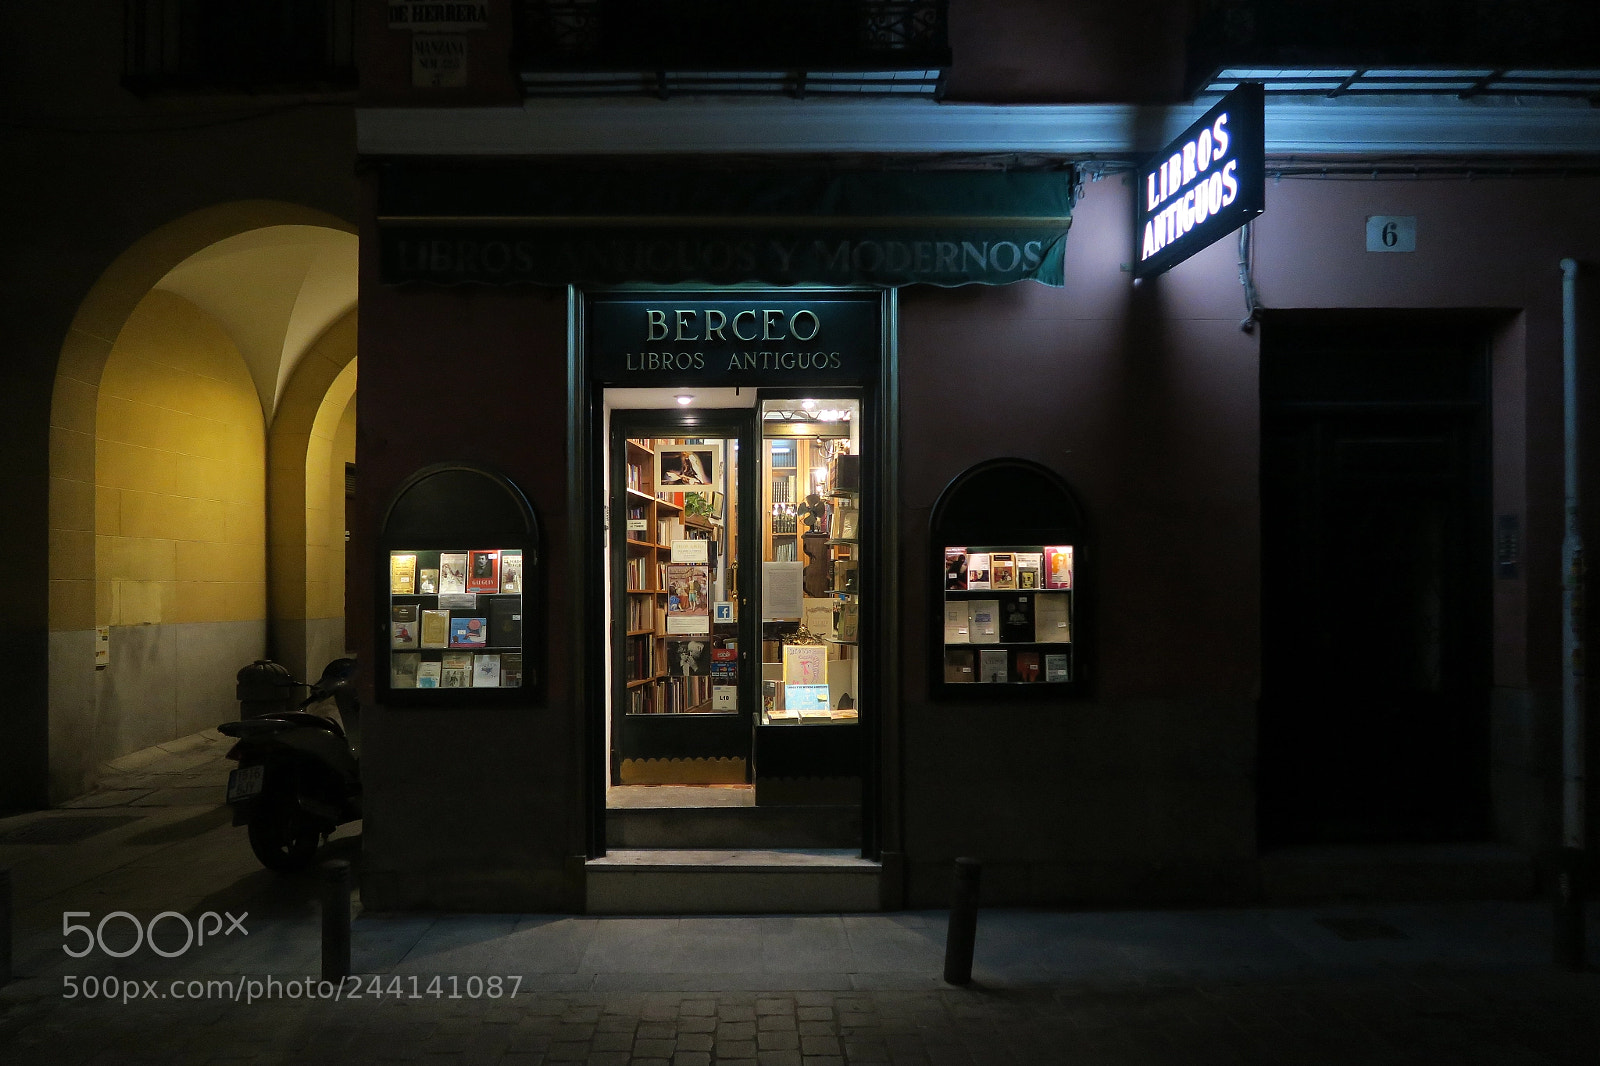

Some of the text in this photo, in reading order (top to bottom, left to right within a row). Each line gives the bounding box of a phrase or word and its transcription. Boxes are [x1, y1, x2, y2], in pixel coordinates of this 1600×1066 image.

[412, 5, 487, 22] HERRERA
[1147, 112, 1229, 212] LIBROS
[1141, 159, 1238, 261] ANTIGUOS
[1382, 221, 1398, 248] 6
[398, 239, 535, 272] LIBROS
[771, 240, 799, 272] Y
[814, 239, 1042, 273] MODERNOS
[646, 308, 821, 342] BERCEO
[626, 351, 842, 371] LIBROS ANTIGUOS
